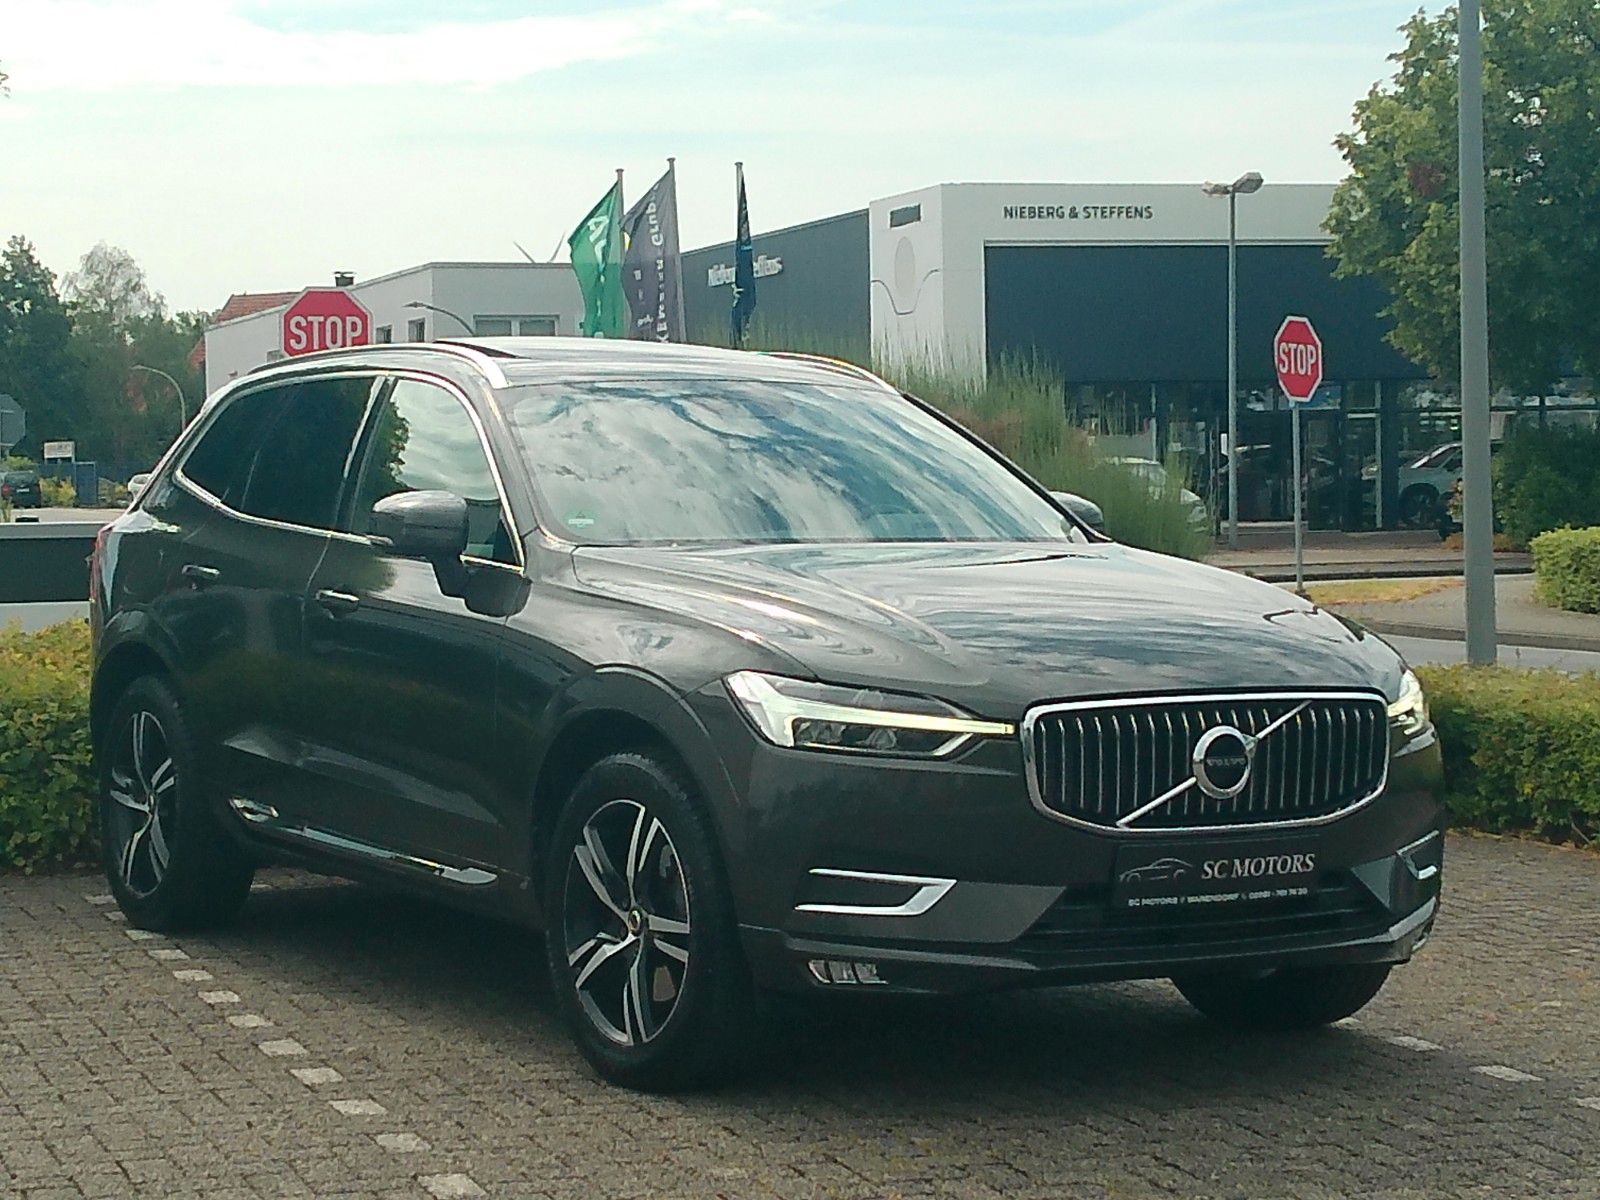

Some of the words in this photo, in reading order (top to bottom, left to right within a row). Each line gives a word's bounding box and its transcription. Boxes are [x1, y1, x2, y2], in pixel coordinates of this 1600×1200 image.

[1003, 205, 1065, 219] NIEBERG
[1068, 205, 1079, 219] &
[1082, 205, 1154, 219] STEFFENS
[289, 315, 363, 350] STOP
[1279, 342, 1317, 376] STOP
[1201, 860, 1229, 879] SC
[1231, 853, 1316, 879] MOTORS
